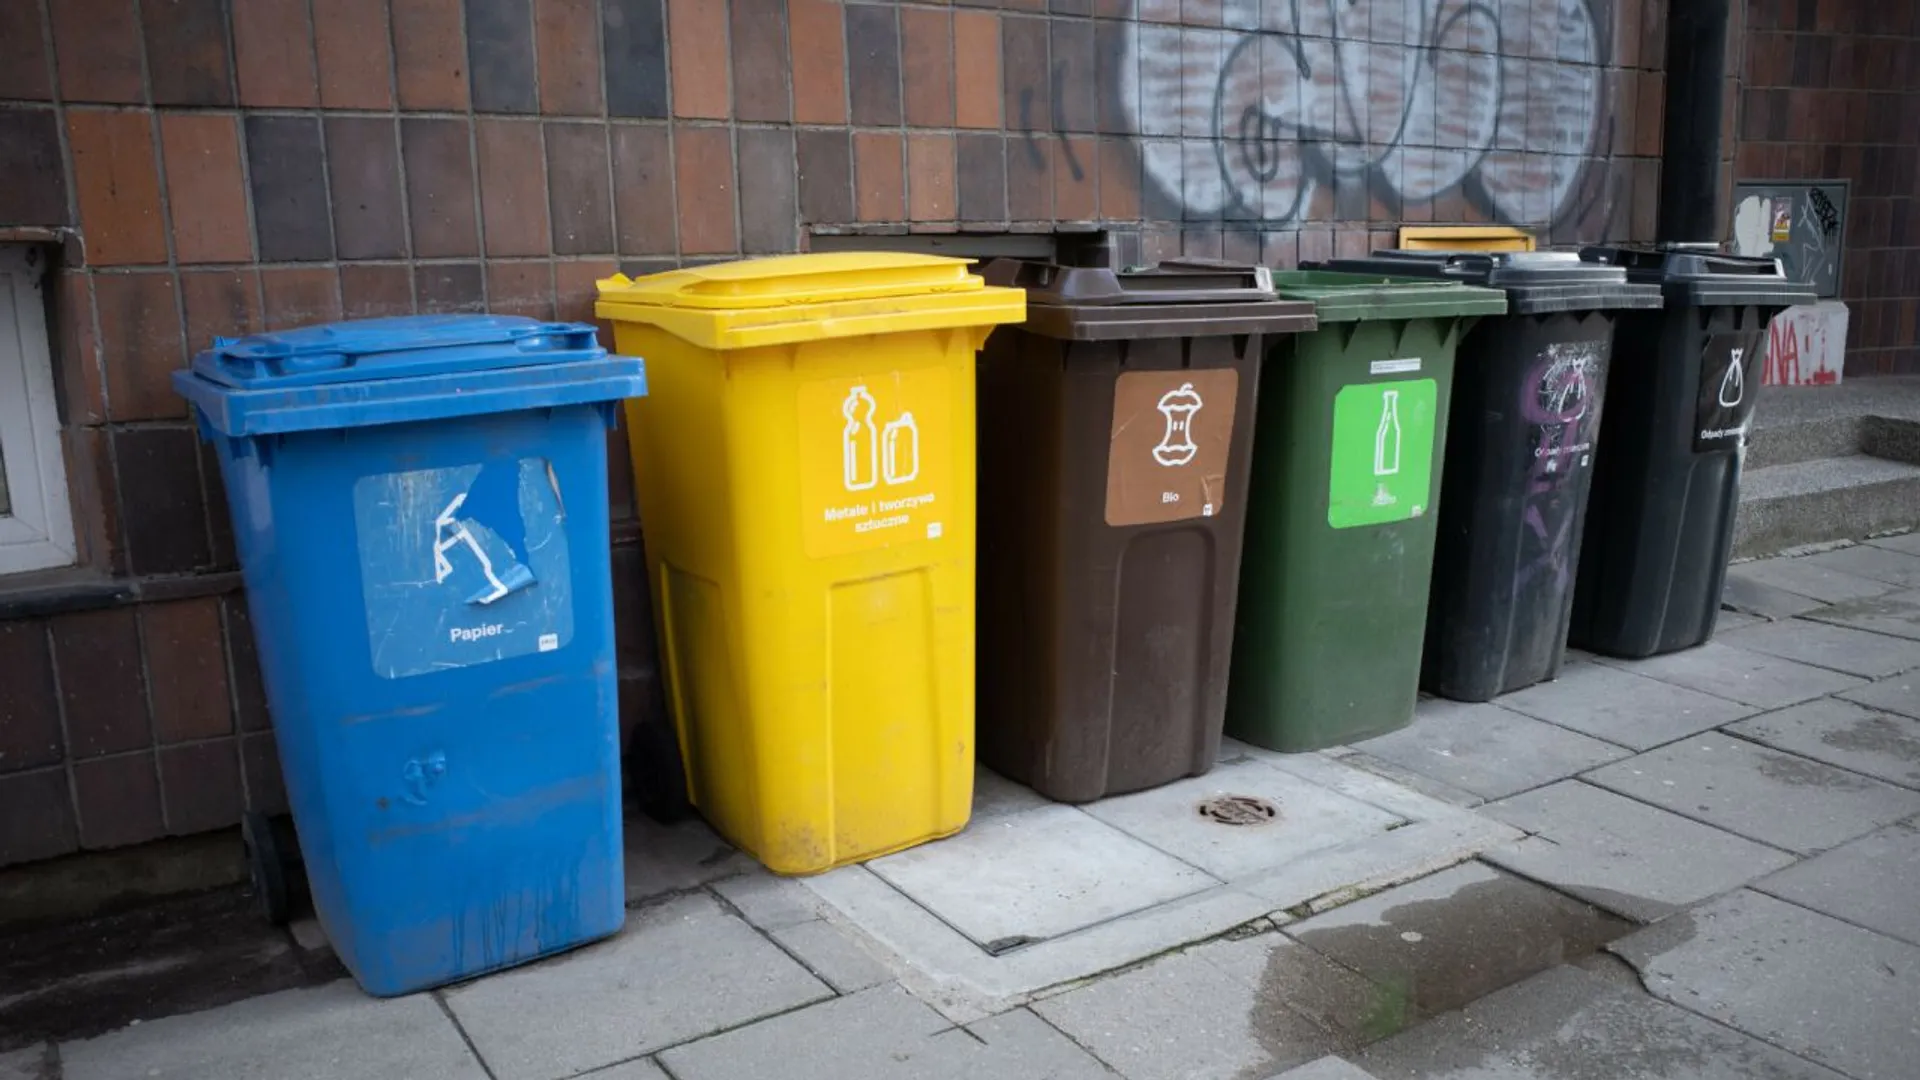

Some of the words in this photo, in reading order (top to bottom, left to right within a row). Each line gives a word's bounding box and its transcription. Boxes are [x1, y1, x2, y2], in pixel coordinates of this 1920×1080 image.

[1162, 492, 1179, 503] Bio
[825, 505, 868, 521] Metale
[855, 515, 909, 532] sztuczne
[450, 623, 503, 643] Papier
